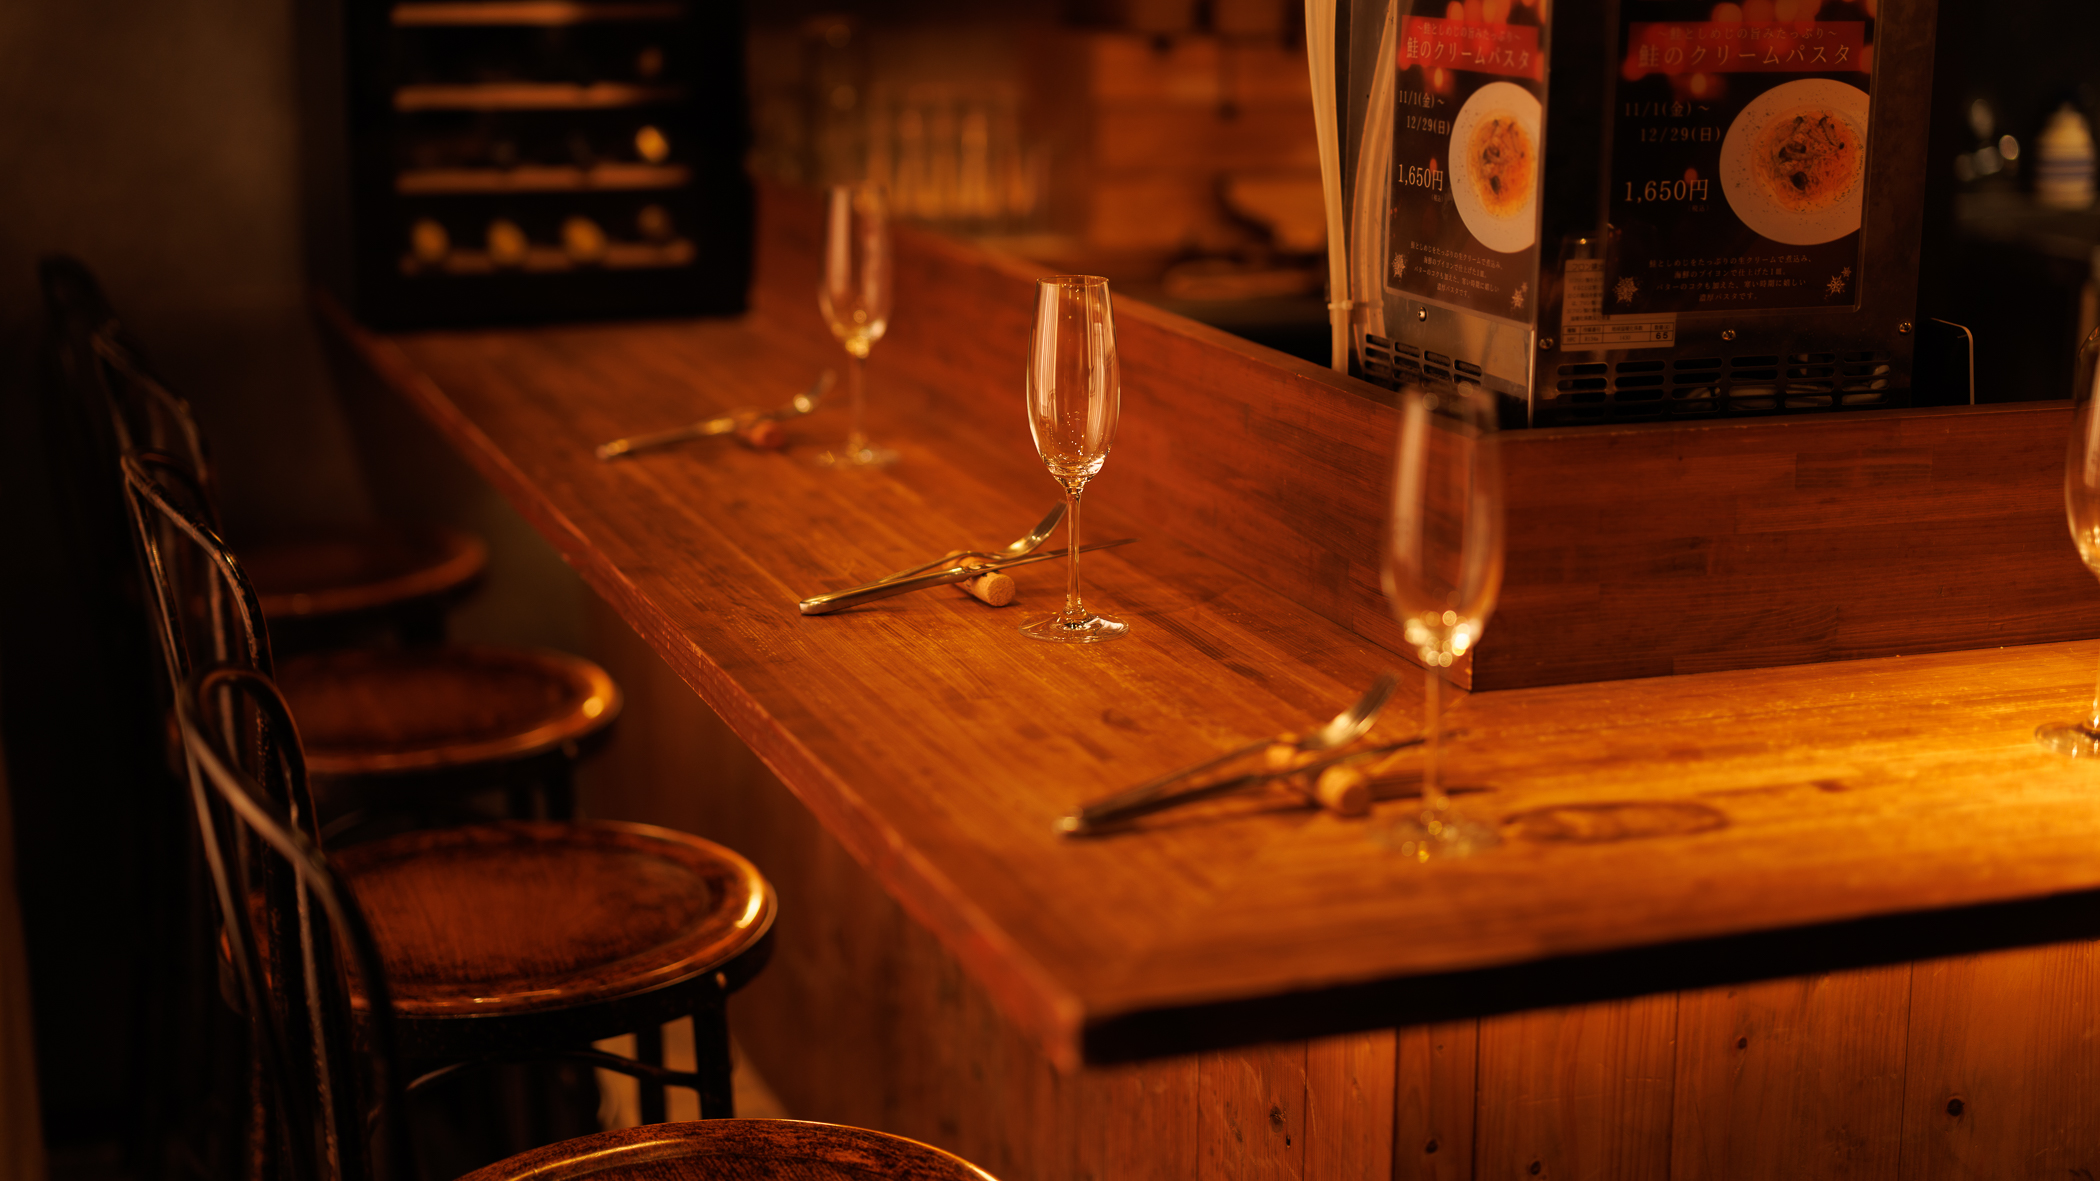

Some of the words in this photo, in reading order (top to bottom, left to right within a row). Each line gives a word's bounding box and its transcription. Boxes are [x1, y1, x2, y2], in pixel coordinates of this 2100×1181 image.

[1406, 36, 1530, 70] 鮭のクリームパスタ
[1638, 43, 1850, 68] 鮭のクリームパスタ
[1406, 115, 1450, 136] 12/29(日)
[1640, 126, 1721, 143] 12/29(日)
[1398, 163, 1443, 192] 1,650円
[1624, 178, 1709, 204] 1,650円
[1655, 331, 1669, 340] 65
